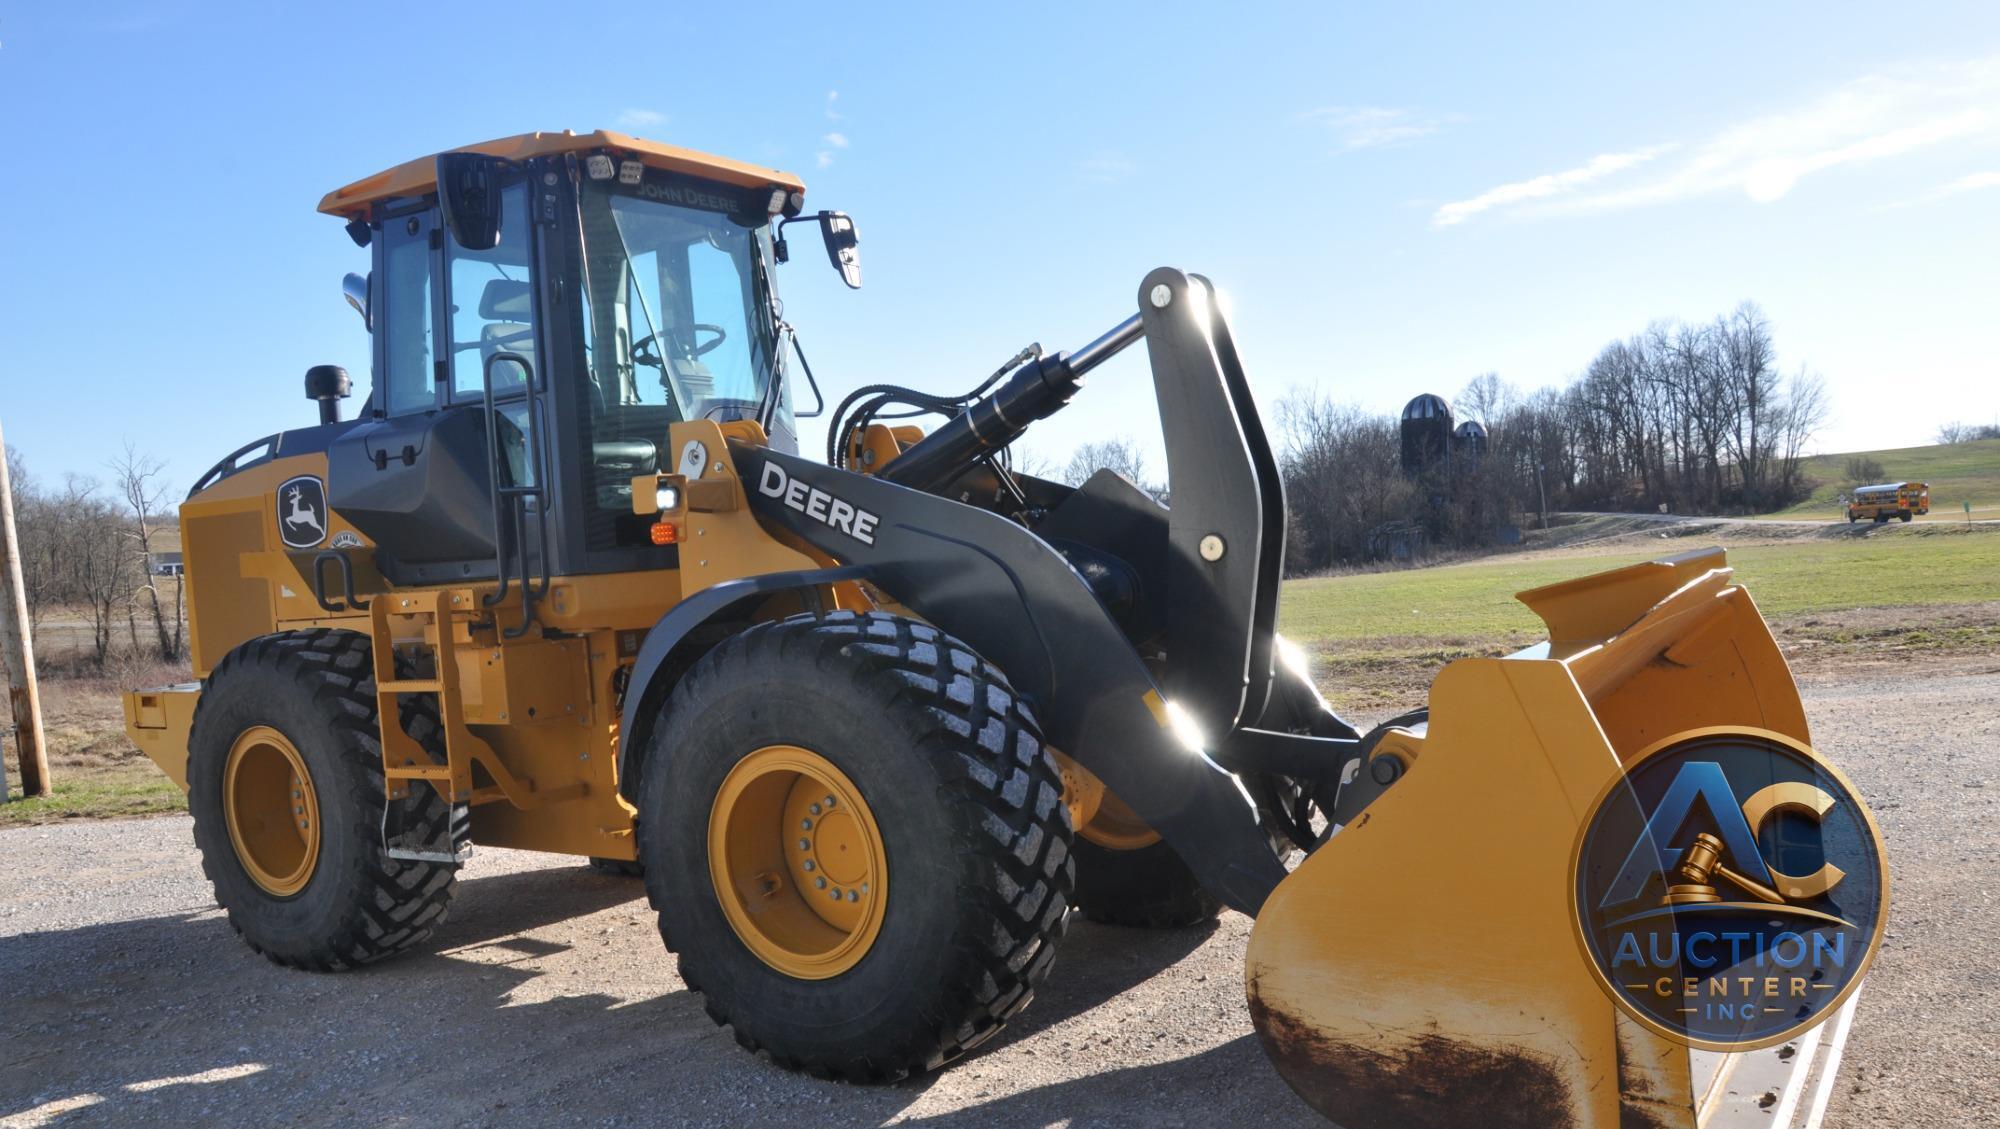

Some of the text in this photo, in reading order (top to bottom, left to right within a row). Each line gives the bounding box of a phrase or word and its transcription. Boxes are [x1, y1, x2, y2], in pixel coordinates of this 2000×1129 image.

[638, 183, 739, 213] JOHN DEERE
[758, 460, 879, 545] DEERE
